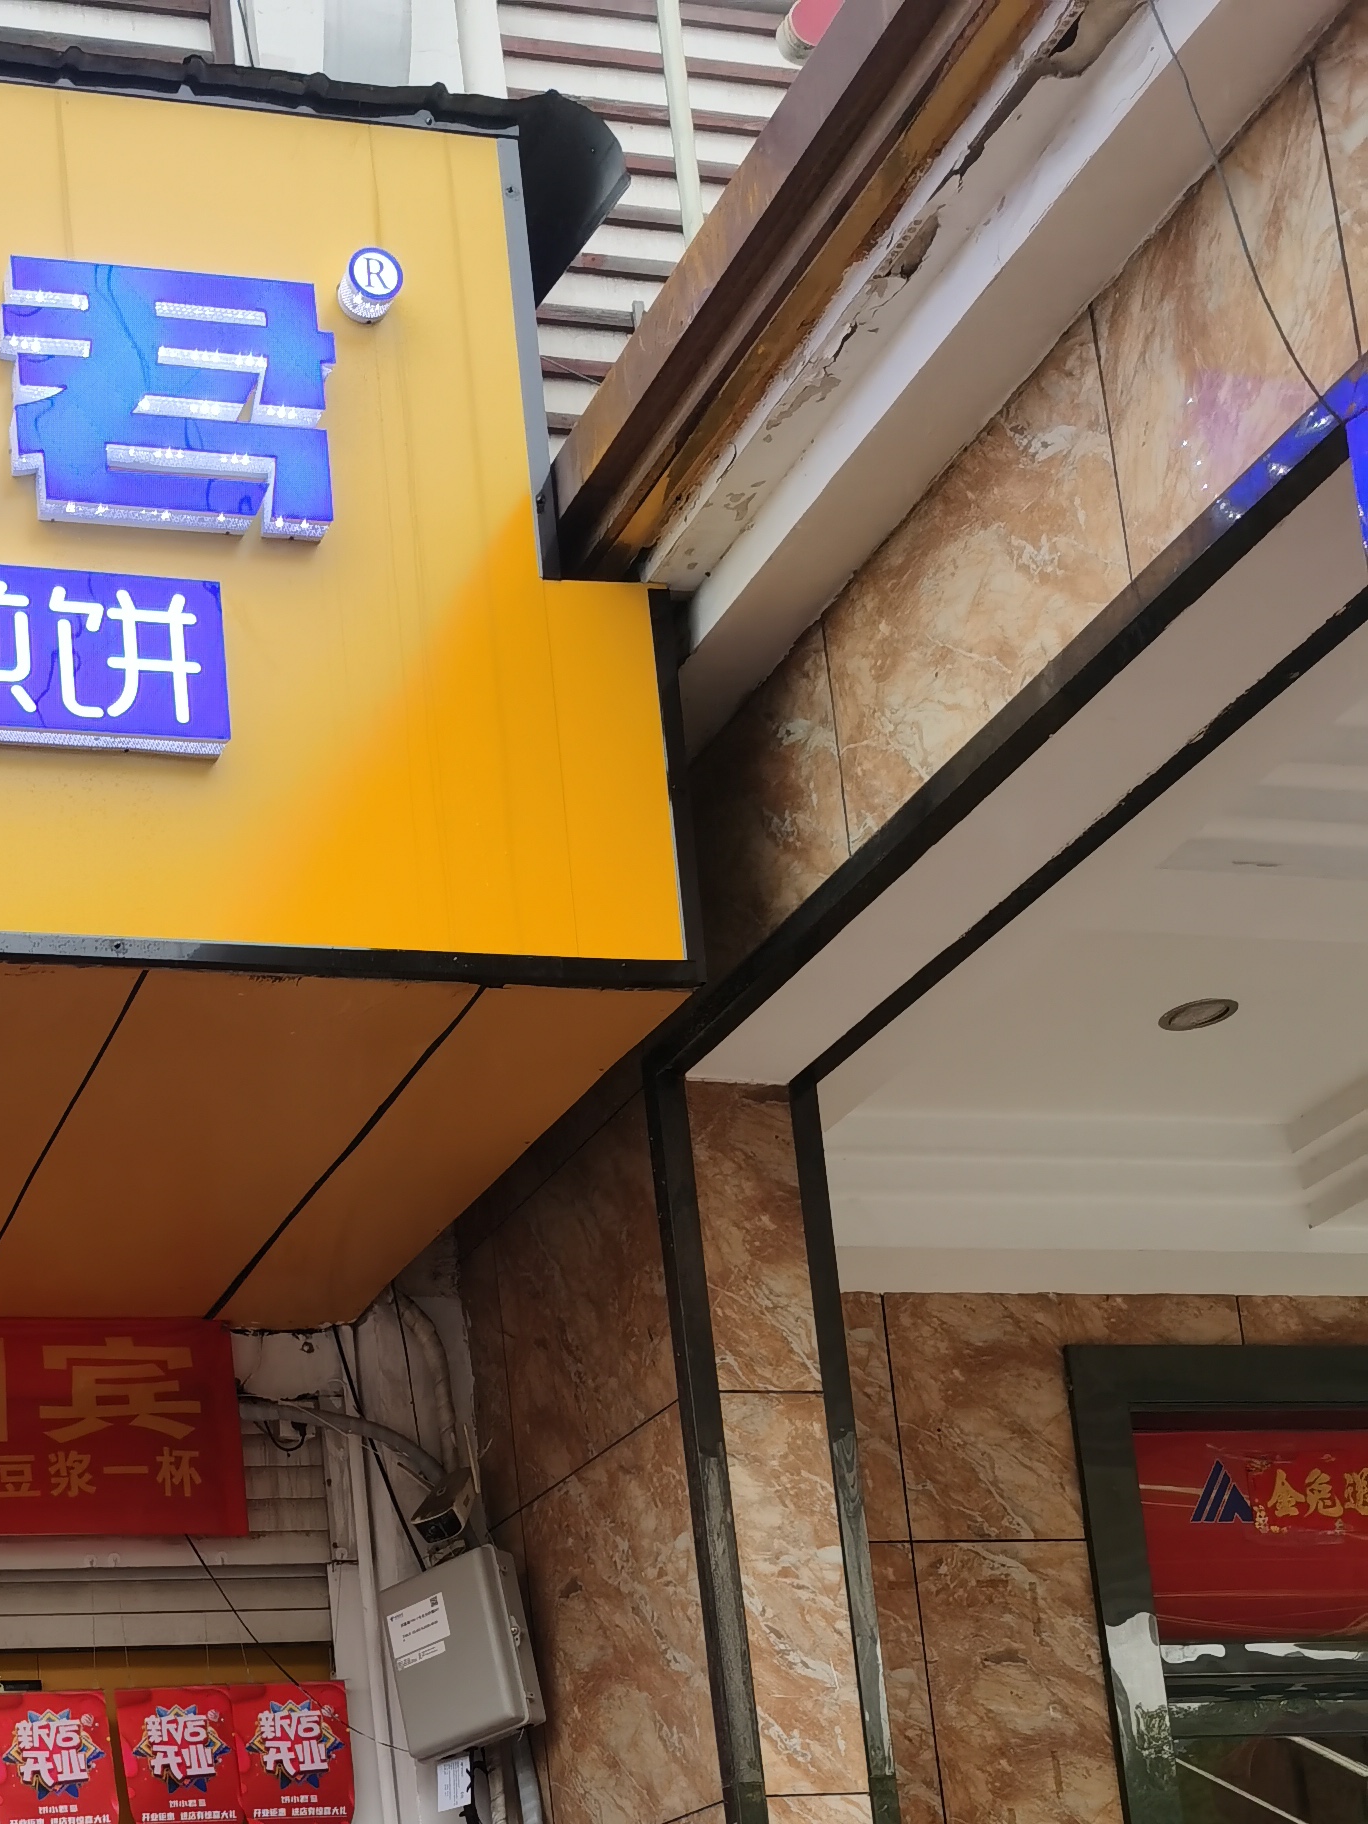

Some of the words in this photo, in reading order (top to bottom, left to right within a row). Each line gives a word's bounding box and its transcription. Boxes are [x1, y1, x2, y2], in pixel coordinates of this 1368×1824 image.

[16, 1718, 81, 1750] 新店
[146, 1714, 207, 1745] 新店
[259, 1710, 321, 1741] 新店
[20, 1750, 89, 1786] 开业
[151, 1744, 216, 1780] 开业
[263, 1740, 329, 1777] 开业
